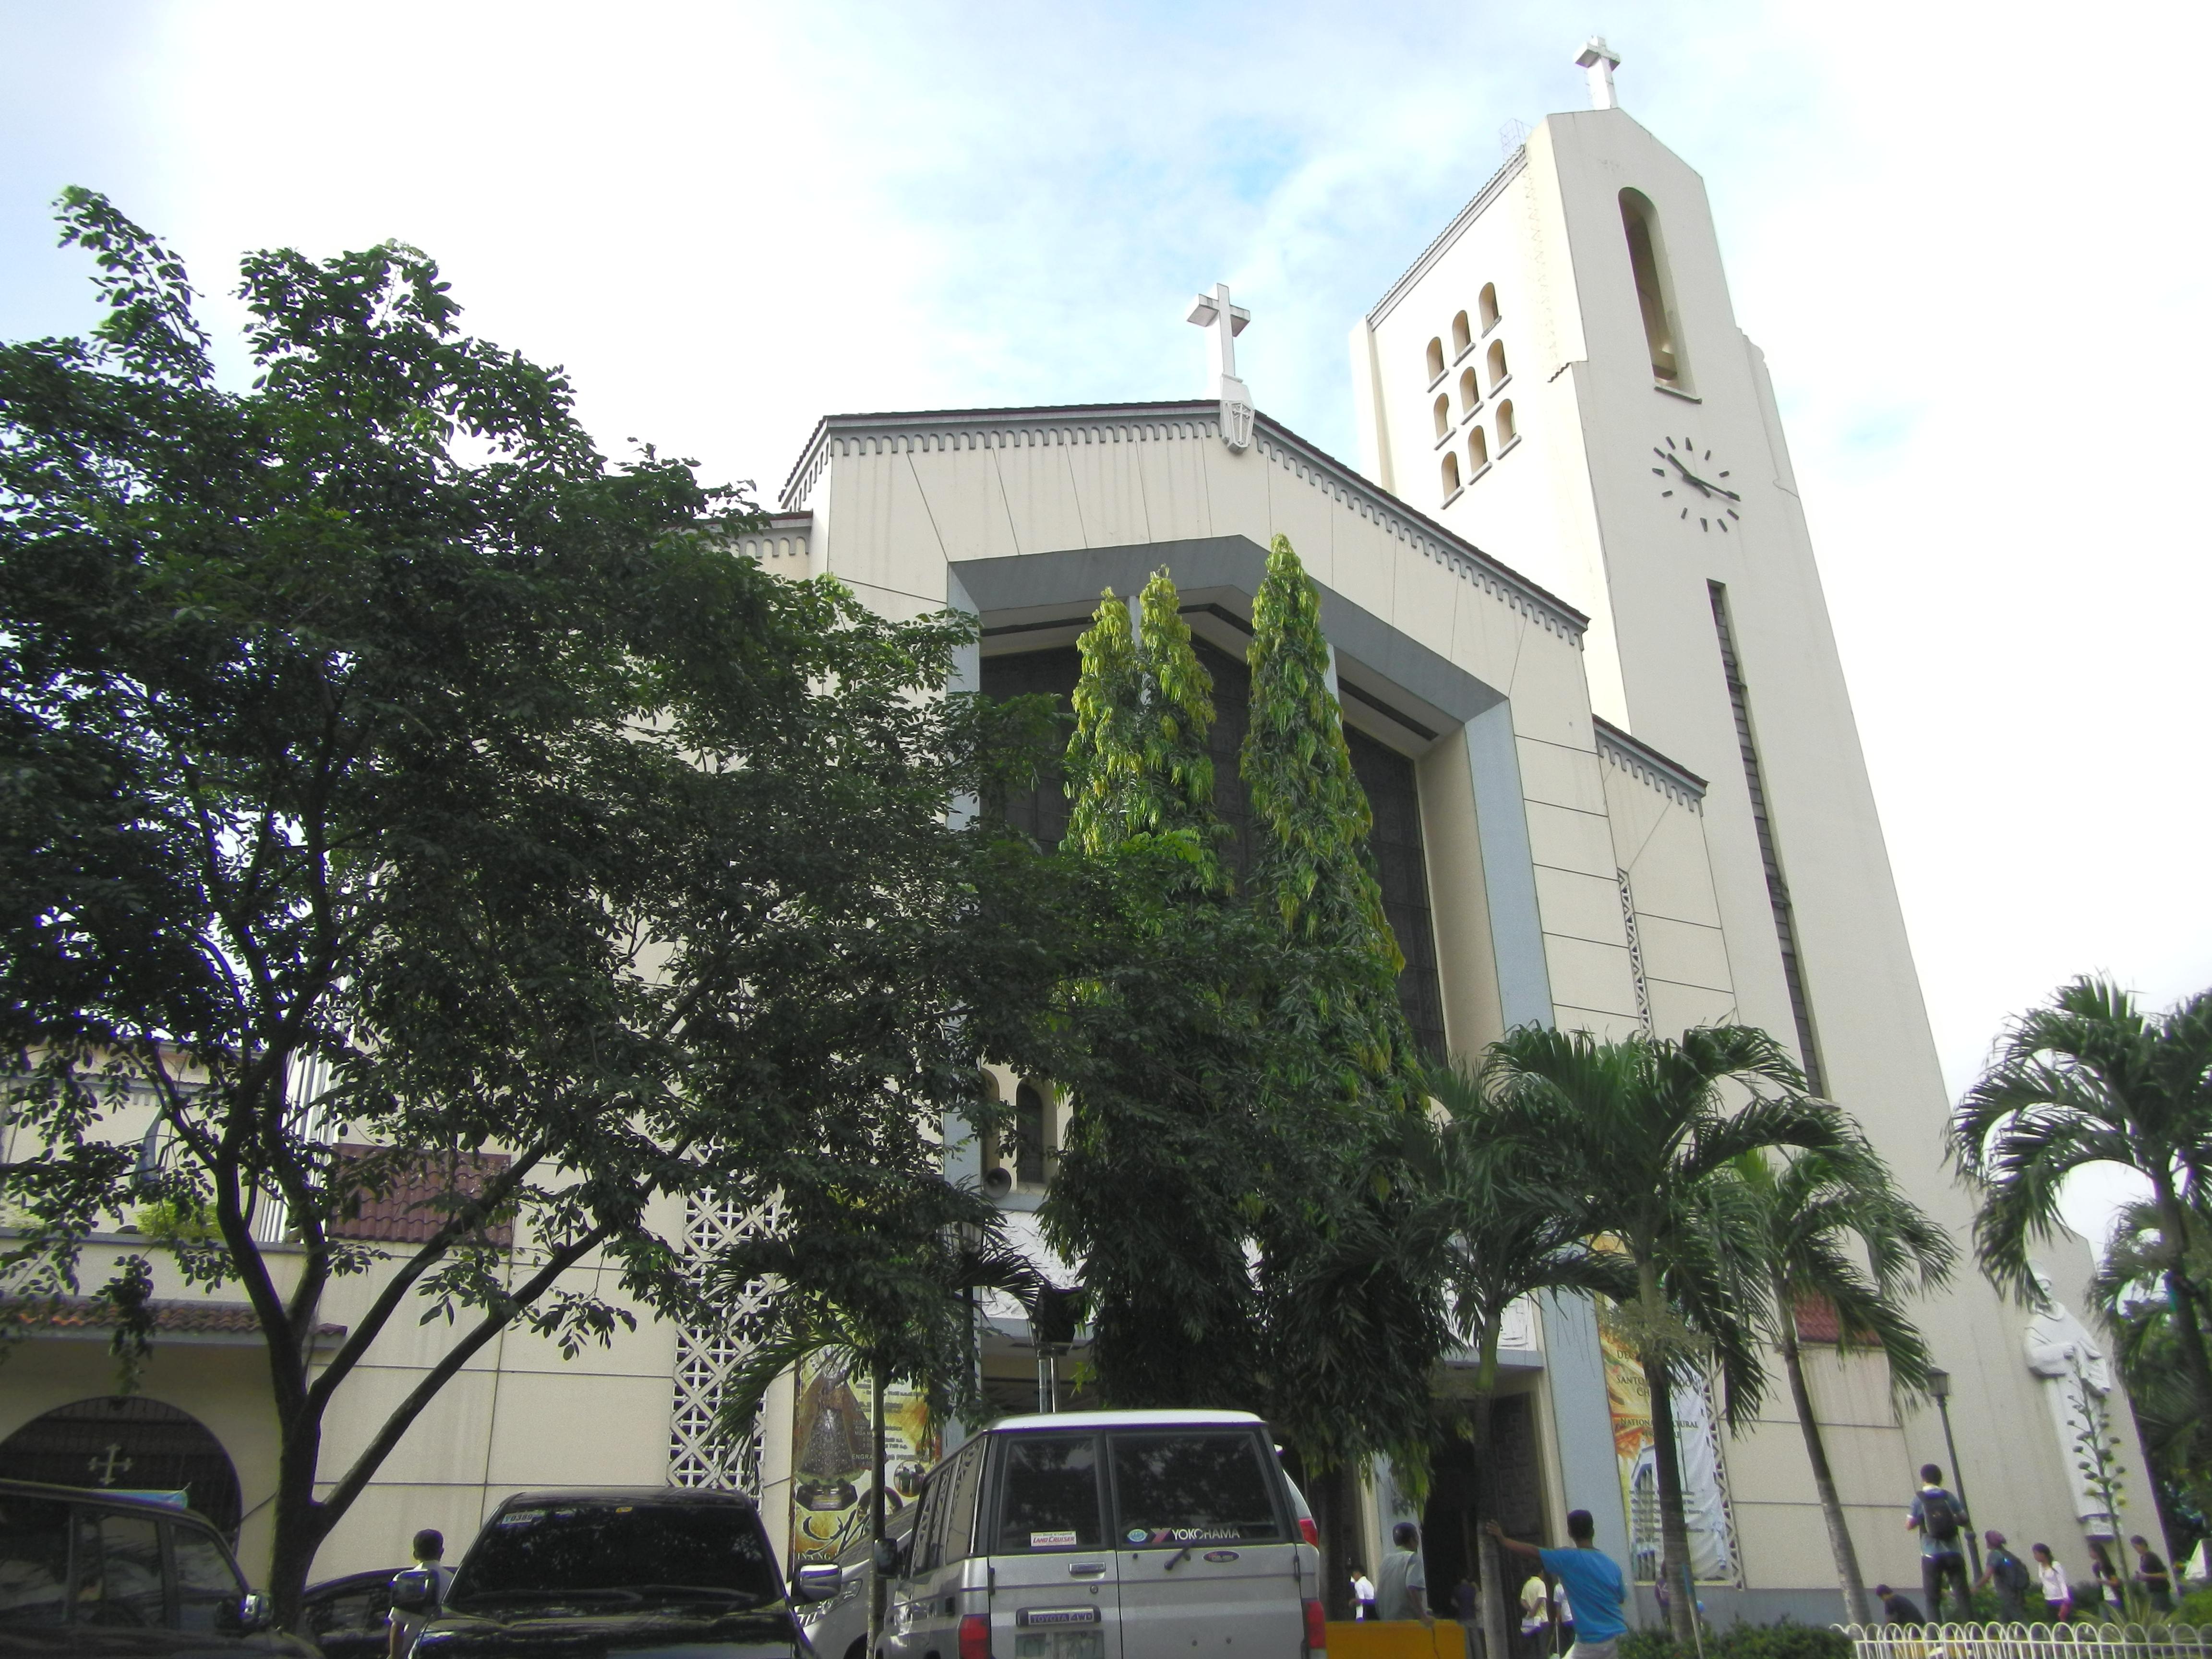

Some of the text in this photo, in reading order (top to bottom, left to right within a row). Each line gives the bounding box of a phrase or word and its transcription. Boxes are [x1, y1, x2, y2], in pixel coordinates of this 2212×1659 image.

[1616, 1375, 1644, 1384] SANTO
[1172, 1528, 1240, 1540] YOKOHAMA
[1033, 1612, 1093, 1623] TOYOTA 4WD
